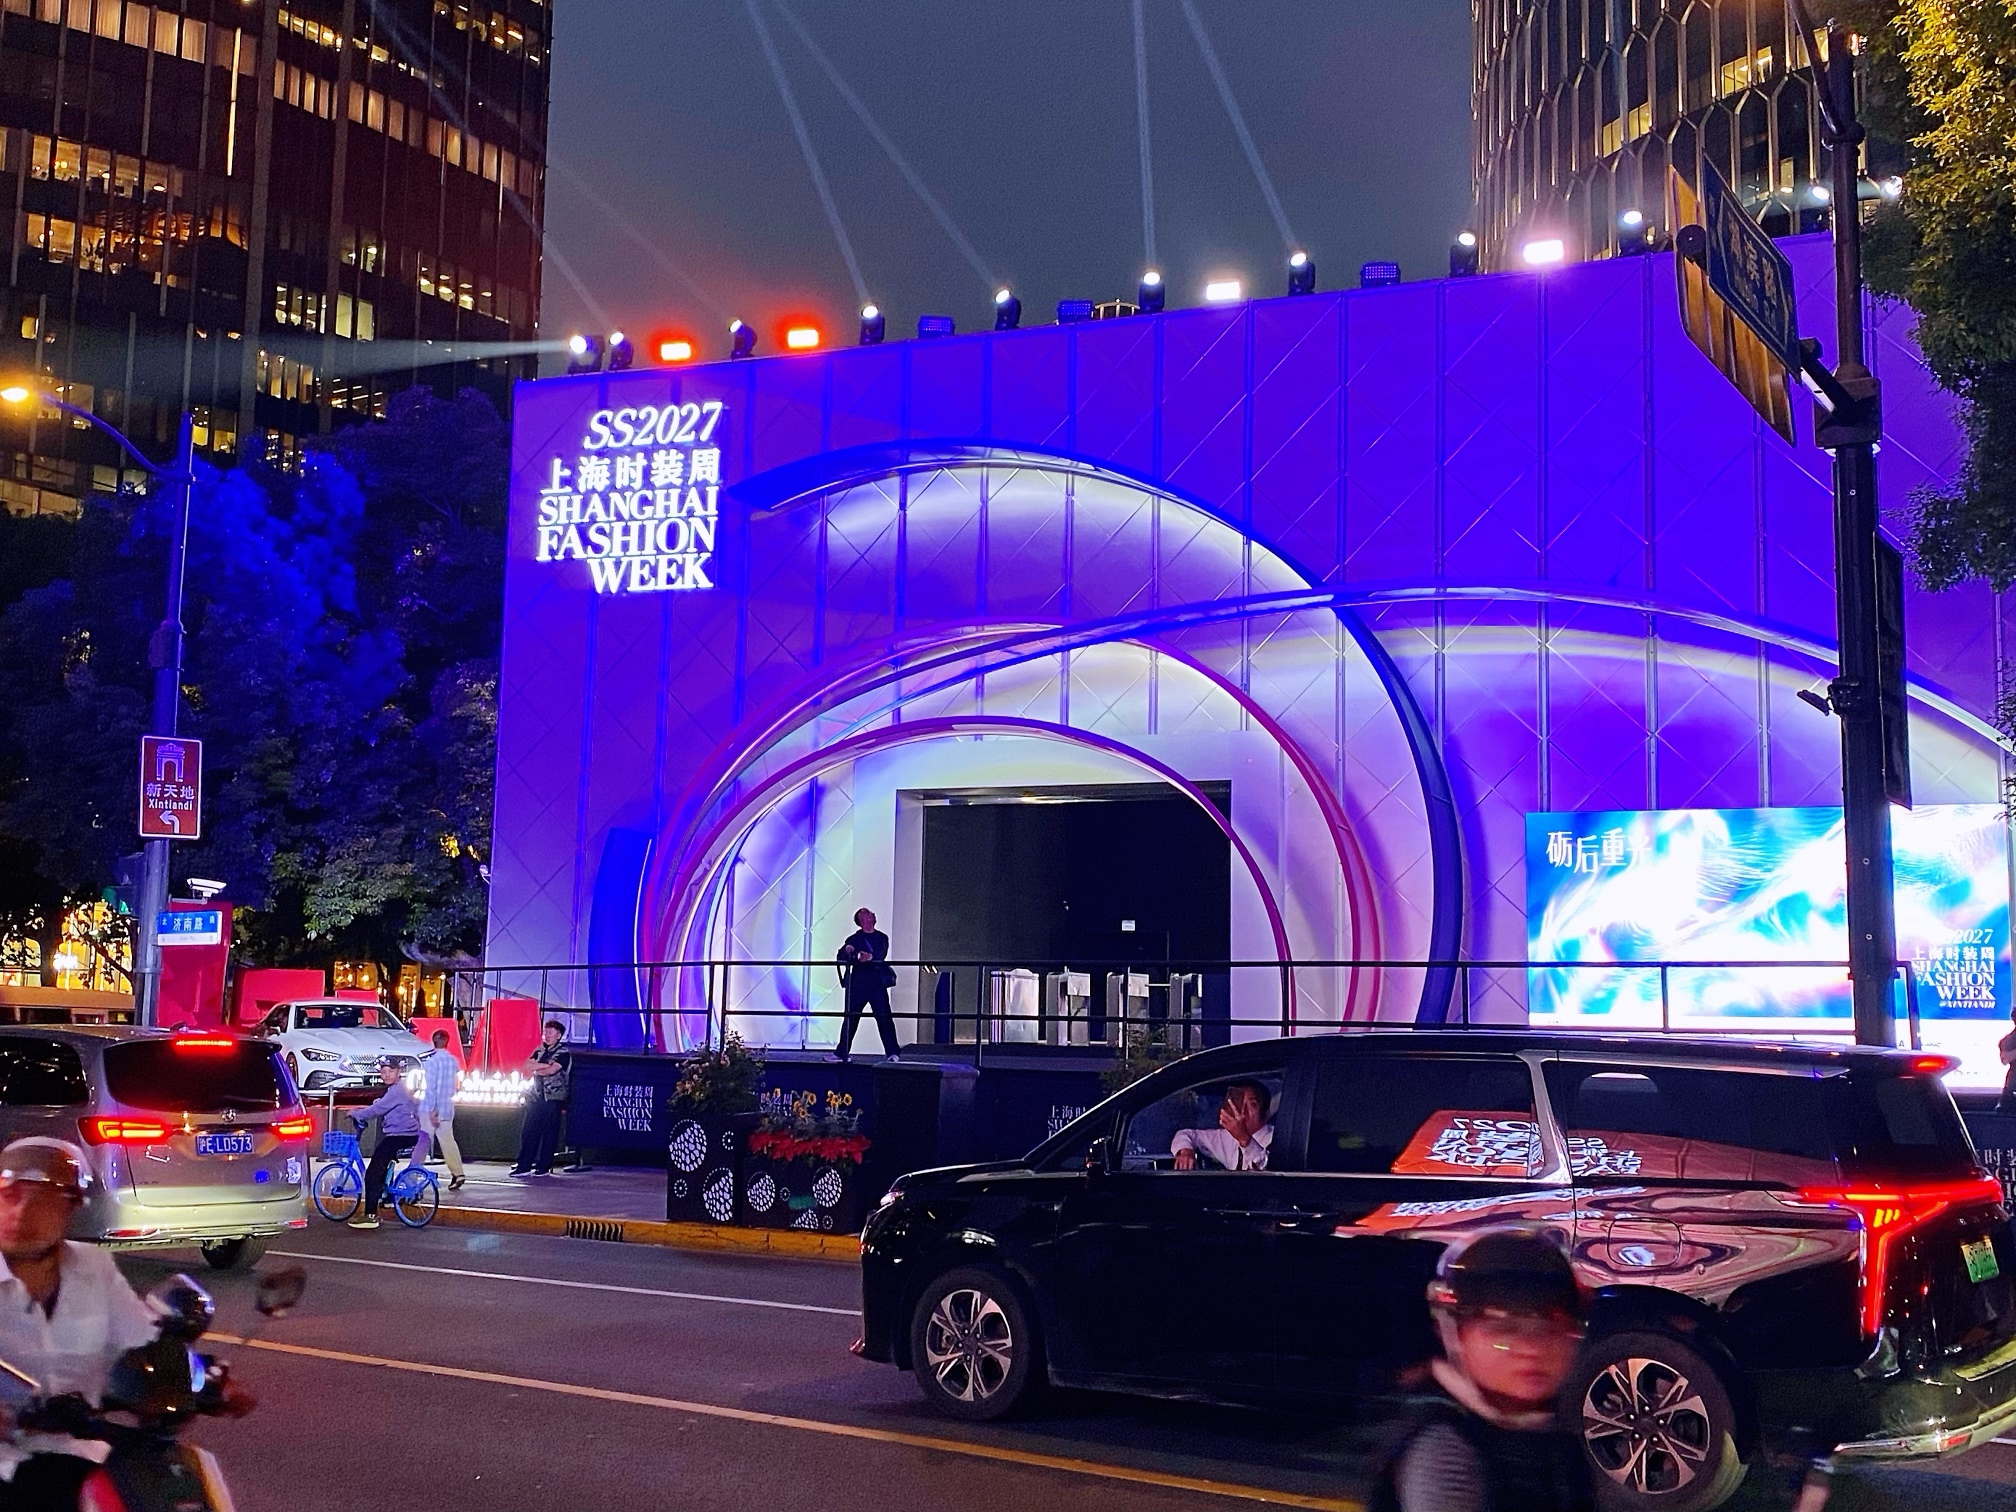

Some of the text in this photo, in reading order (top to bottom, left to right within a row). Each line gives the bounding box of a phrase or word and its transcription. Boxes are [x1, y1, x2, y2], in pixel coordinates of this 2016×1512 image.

[583, 401, 723, 450] SS2027
[540, 447, 721, 495] 上海时装周
[538, 486, 719, 525] SHANGHAI
[536, 517, 718, 562] FASHION
[587, 553, 714, 594] WEEK
[147, 783, 195, 800] 新天地
[148, 799, 193, 811] Xintiandi
[173, 916, 203, 931] 济南路
[1943, 928, 1994, 945] 2027
[1911, 945, 1995, 961] 上海时装周
[1911, 960, 1995, 973] SHANGHAI
[1936, 986, 1996, 1001] WEEK
[618, 1118, 652, 1131] WEEK
